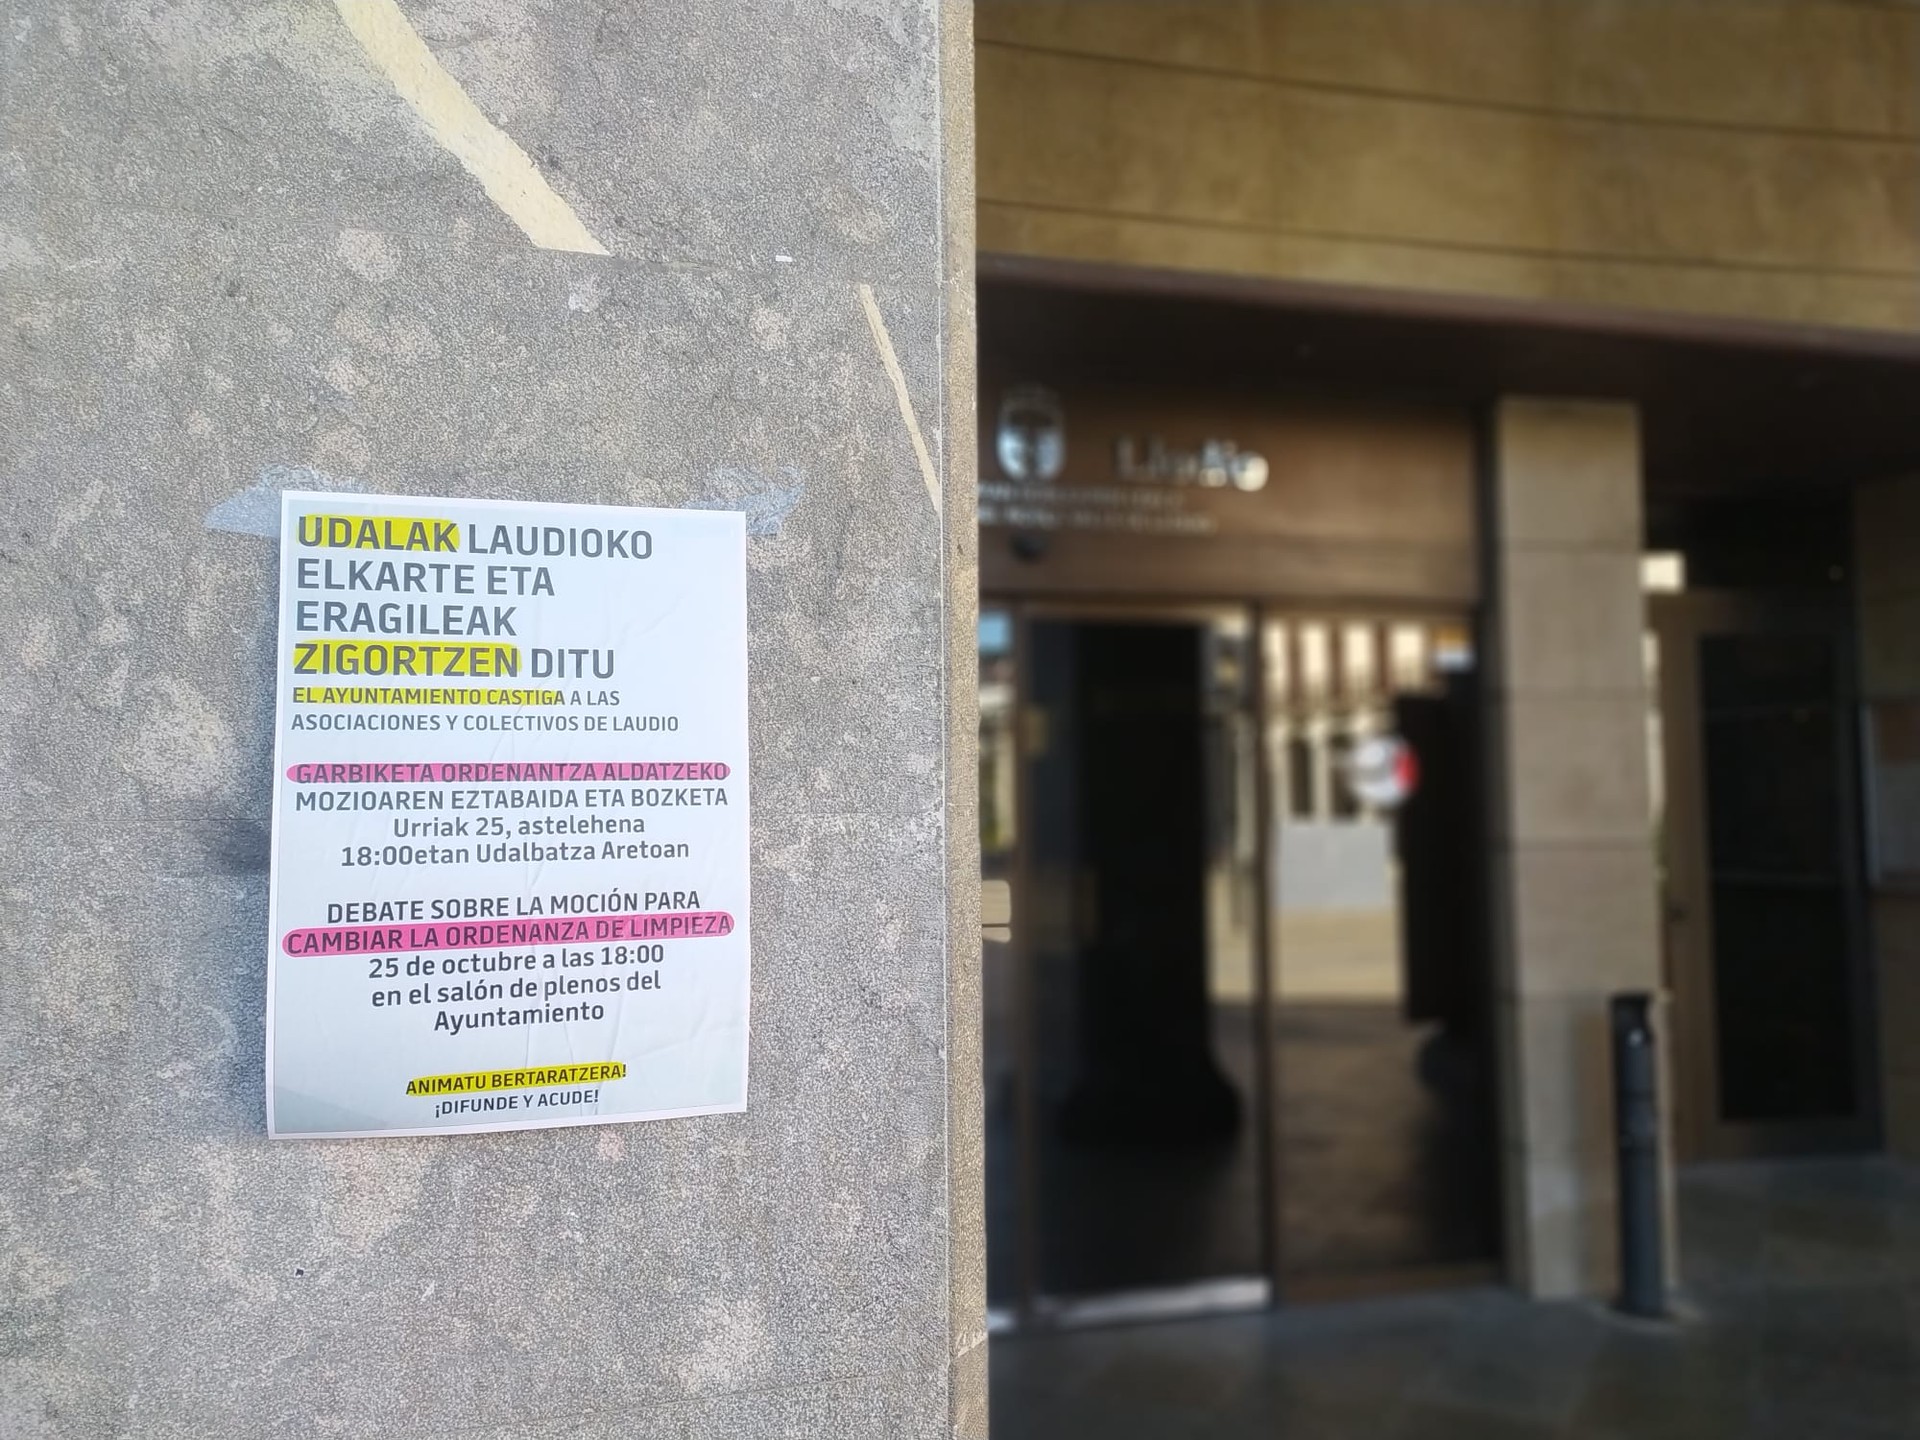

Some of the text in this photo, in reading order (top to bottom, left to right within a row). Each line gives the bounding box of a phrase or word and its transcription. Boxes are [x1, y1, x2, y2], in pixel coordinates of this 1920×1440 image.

[298, 515, 653, 560] UDALAK LAUDIOKO
[297, 558, 555, 597] ELKARTE ETA
[296, 600, 517, 636] ERAGILEAK
[293, 643, 615, 679] ZIGORTZEN DITU
[292, 687, 620, 707] EL AYUNTAMIENTO CASTIGA A LAS
[290, 713, 679, 732] ASOCIACIONES Y COLECTIVOS DE LAUDIO
[295, 762, 728, 784] GARBIKETA ORDENANTZA ALDATZEKO
[295, 788, 728, 812] MOZIOAREN EZTABAIDA ETA BOZKETA
[393, 816, 645, 840] Urriak 25, astelehena
[341, 841, 690, 867] 18:00etan Udalbatza Aretoan
[327, 887, 701, 924] DEBATE SOBRE LA MOCIÓN PARA
[287, 914, 732, 955] CAMBIAR LA ORDENANZA DE LIMPIEZA
[368, 944, 664, 979] 25 de octubre a las 18:00
[372, 970, 661, 1008] en el salón de plenos del
[434, 1001, 604, 1036] Ayuntamiento
[405, 1063, 627, 1096] ANIMATU BERTARATZERA!
[434, 1089, 600, 1119] ¡DIFUNDE Y ACUDE!
